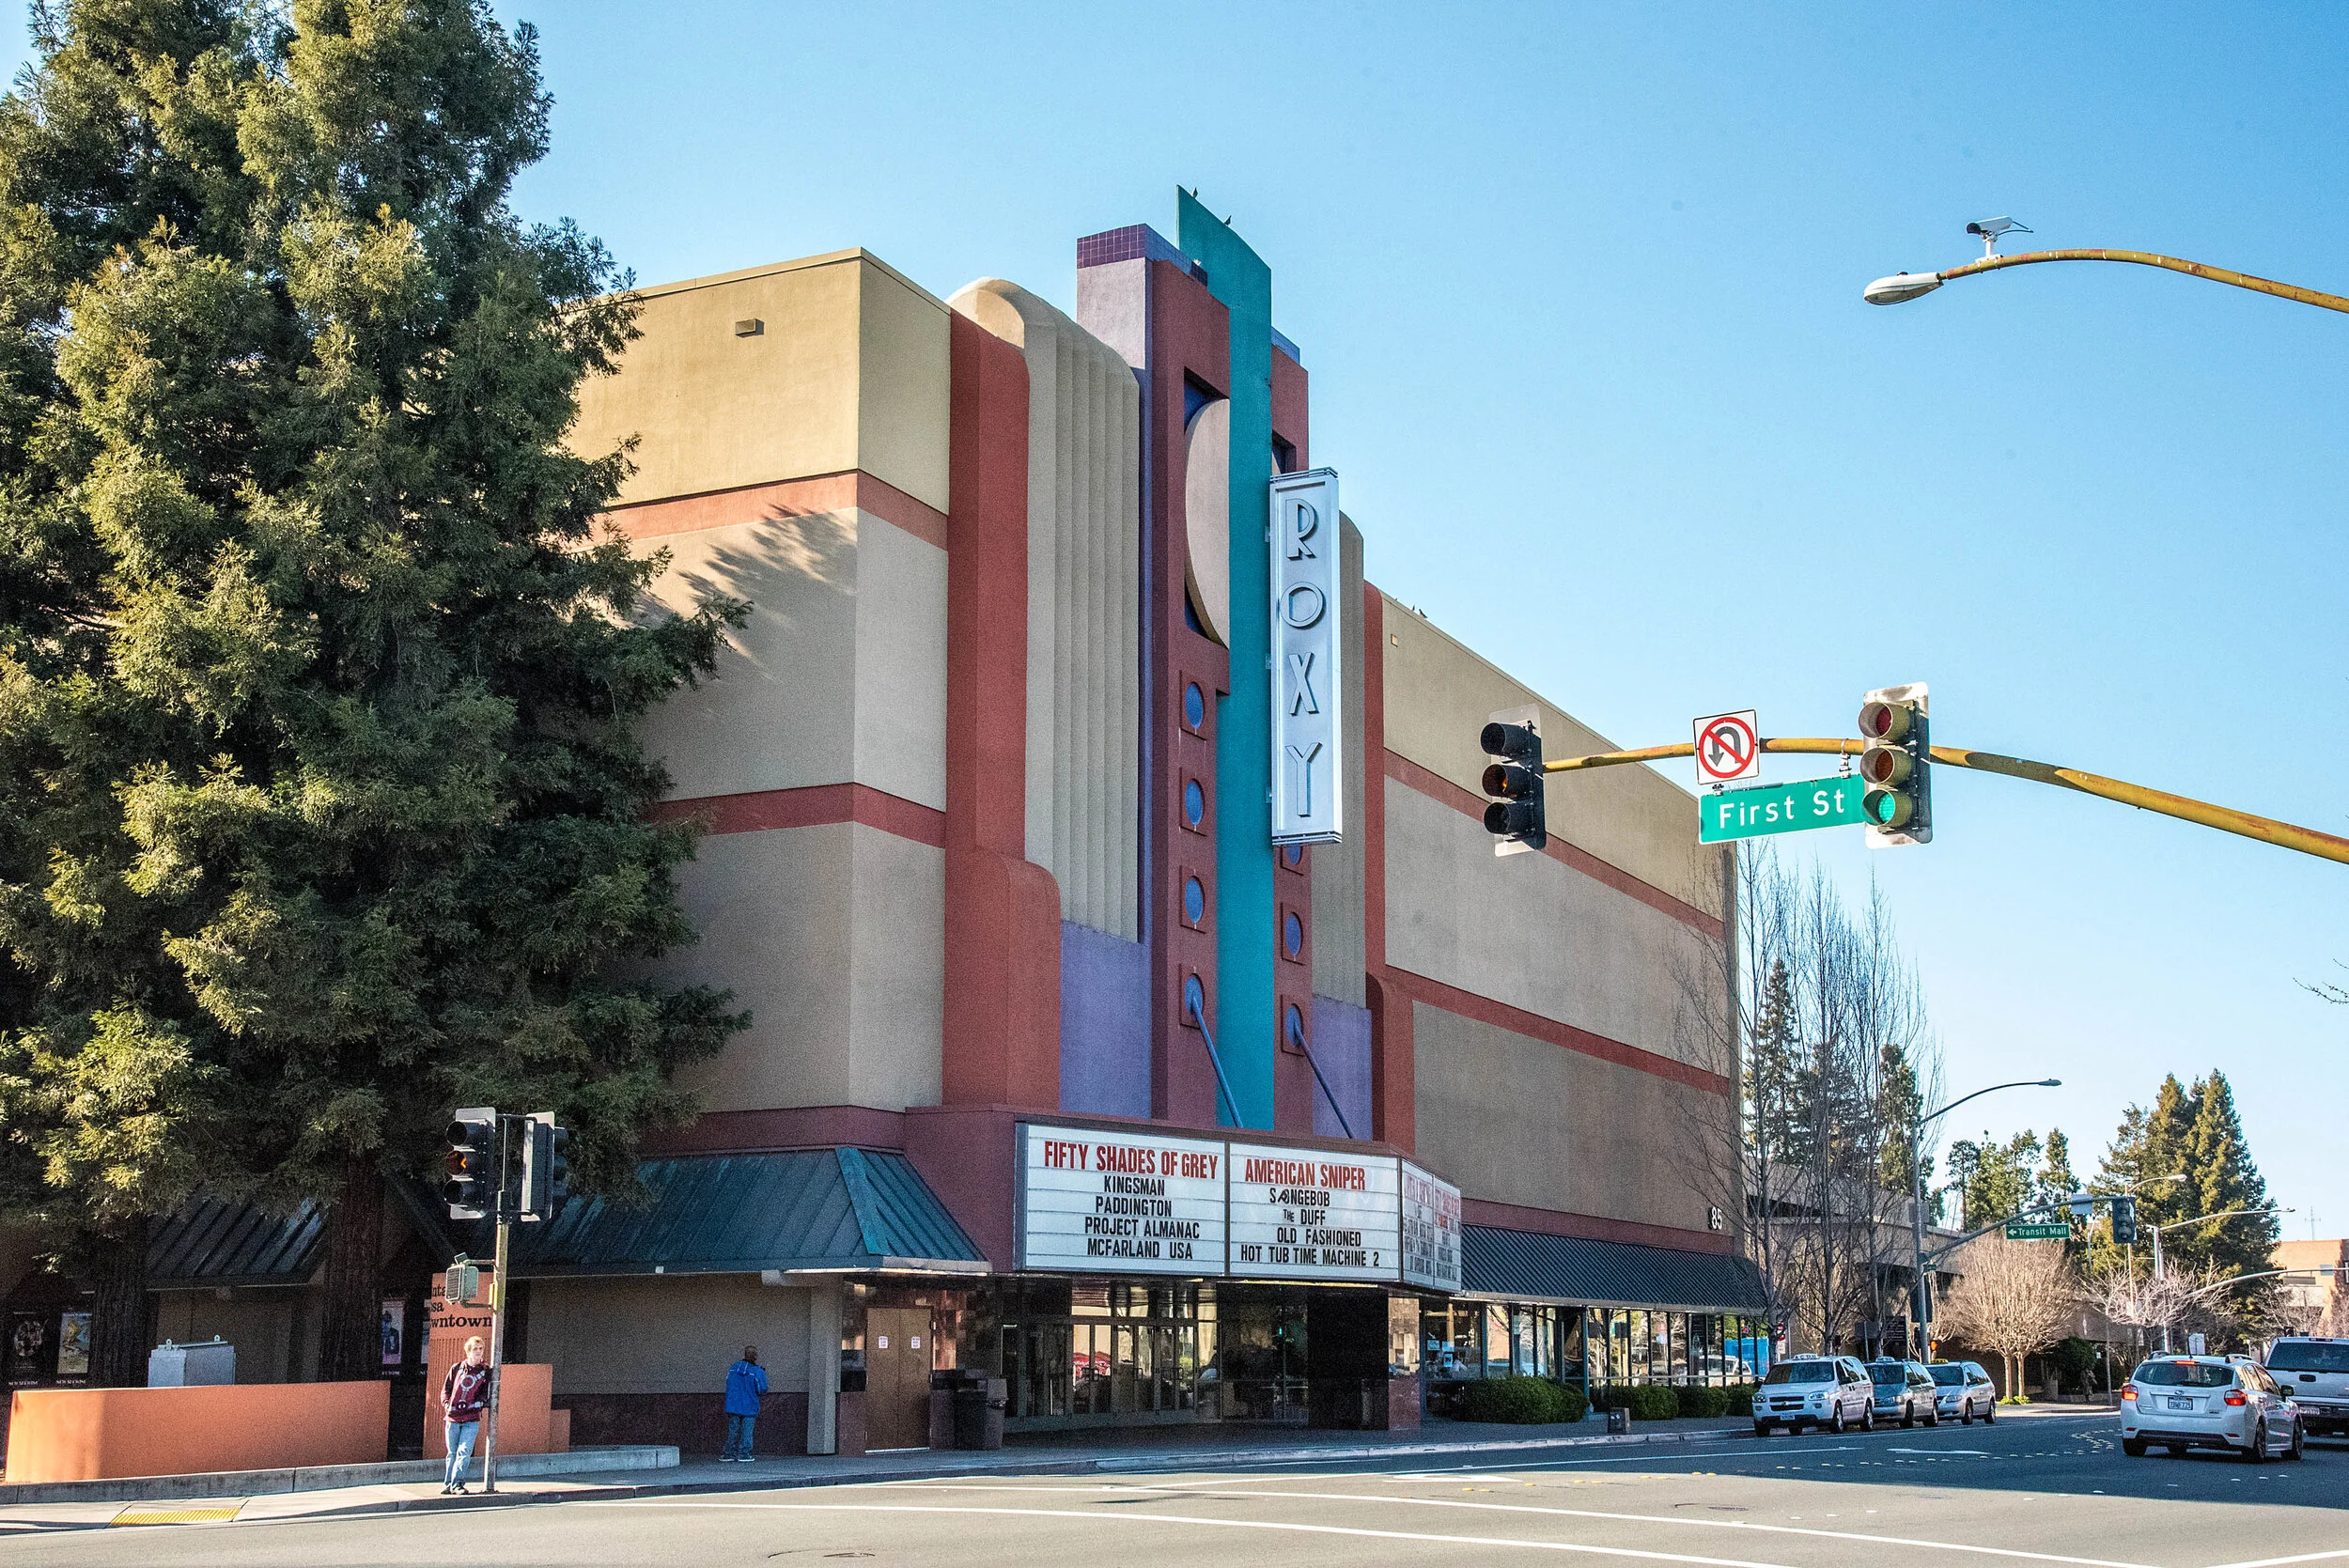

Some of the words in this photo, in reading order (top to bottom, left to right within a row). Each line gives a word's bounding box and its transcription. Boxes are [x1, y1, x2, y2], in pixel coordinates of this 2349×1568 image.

[1279, 498, 1326, 818] ROXY
[1719, 795, 1795, 829] First
[1812, 788, 1845, 815] St
[1044, 1141, 1089, 1170] FIFTY
[1097, 1145, 1156, 1174] SHADES
[1160, 1151, 1177, 1176] OF
[1181, 1153, 1219, 1180] GREY
[1245, 1158, 1315, 1187] AMERICAN
[1320, 1163, 1365, 1190] SNIPER
[1104, 1175, 1165, 1196] KINGSMAN
[1096, 1195, 1172, 1217] PADDINGTON
[1283, 1208, 1295, 1222] THE
[1300, 1208, 1326, 1226] DUFF
[1084, 1216, 1139, 1236] PROJECT
[1143, 1219, 1200, 1239] ALMANAC
[1711, 1205, 1722, 1231] 85
[1277, 1227, 1297, 1244] OLD
[1305, 1229, 1361, 1247] FASHIONED
[2017, 1228, 2046, 1236] Transit
[2049, 1227, 2066, 1235] Mall
[1087, 1238, 1160, 1258] MCFARLAND
[1169, 1242, 1193, 1260] USA
[1240, 1244, 1262, 1263] HOT
[1268, 1247, 1289, 1263] TUB
[1293, 1248, 1316, 1265] TIME
[1322, 1249, 1366, 1266] MACHINE
[1373, 1251, 1379, 1266] 2
